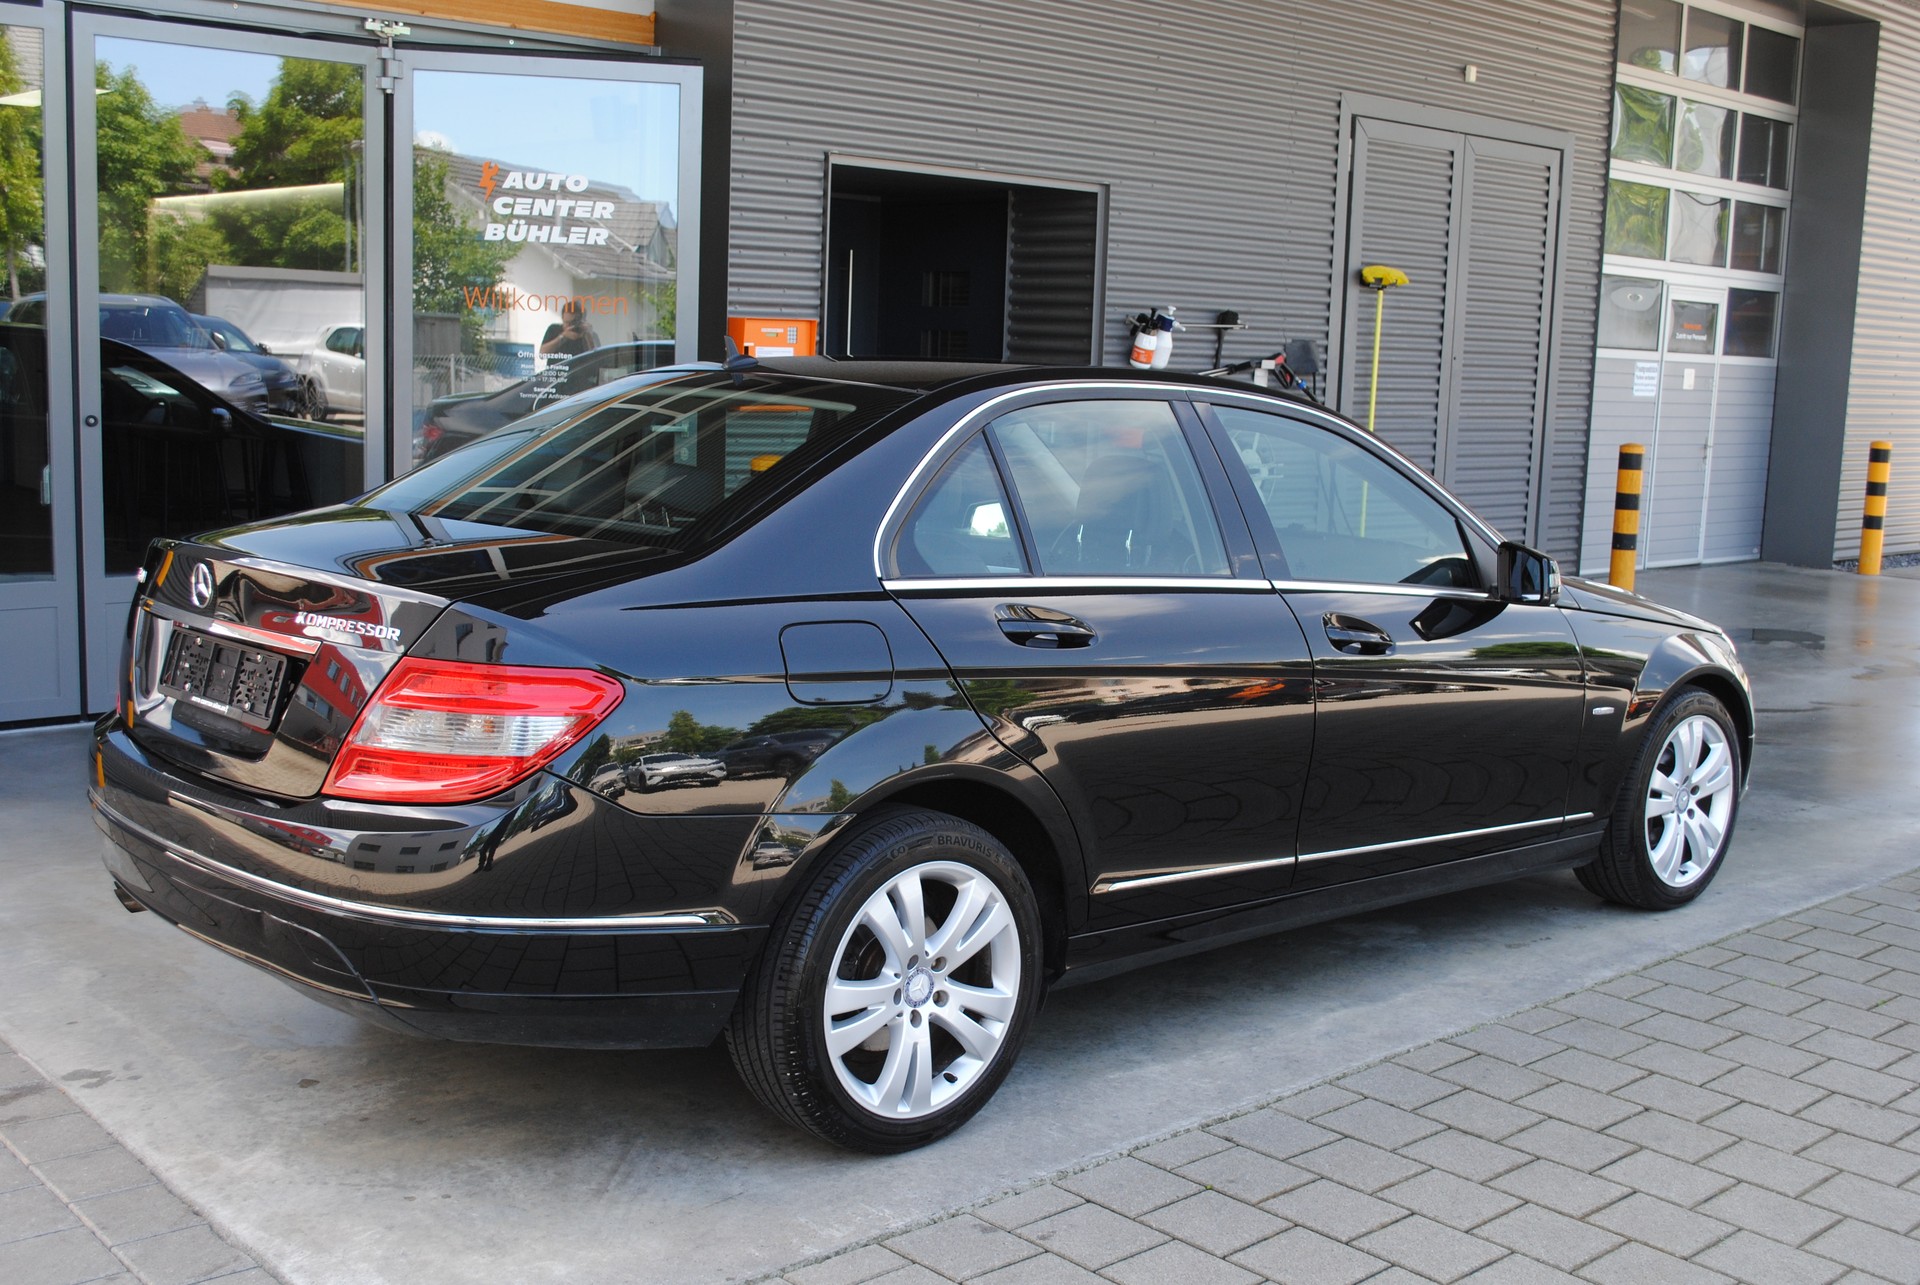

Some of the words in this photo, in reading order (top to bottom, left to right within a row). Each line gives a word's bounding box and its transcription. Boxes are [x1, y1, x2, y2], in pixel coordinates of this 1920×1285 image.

[502, 171, 589, 193] AUTO
[493, 196, 615, 219] CENTER
[484, 219, 609, 245] BÜHLER
[463, 285, 629, 316] Willkommen
[295, 611, 401, 641] KOMPRESSOR
[937, 834, 992, 858] BRAVURIS
